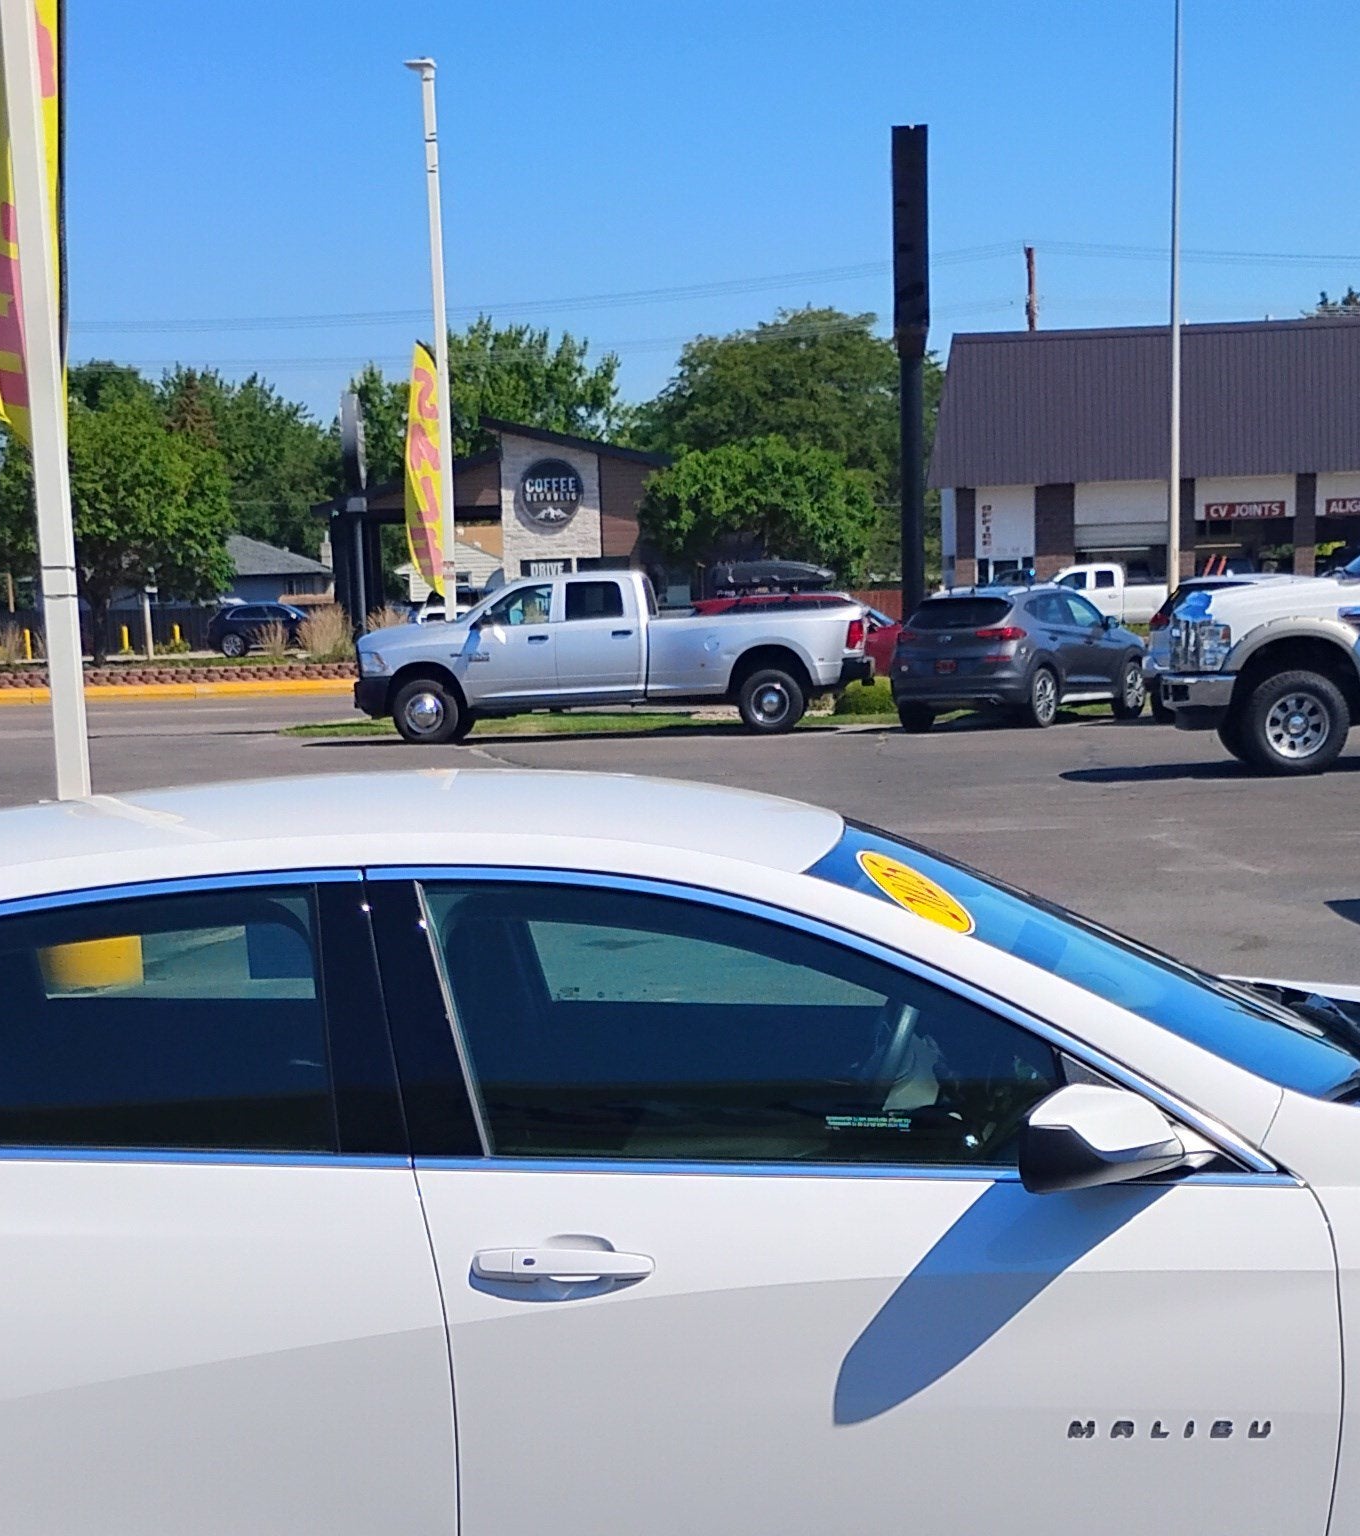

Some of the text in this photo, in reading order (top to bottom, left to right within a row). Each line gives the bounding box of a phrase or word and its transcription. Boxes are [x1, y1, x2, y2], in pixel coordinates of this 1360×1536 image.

[525, 477, 577, 493] COFFEE
[1209, 502, 1281, 518] CV JOINTS
[530, 562, 564, 577] DRIVE
[1067, 1421, 1272, 1439] MALIBU
